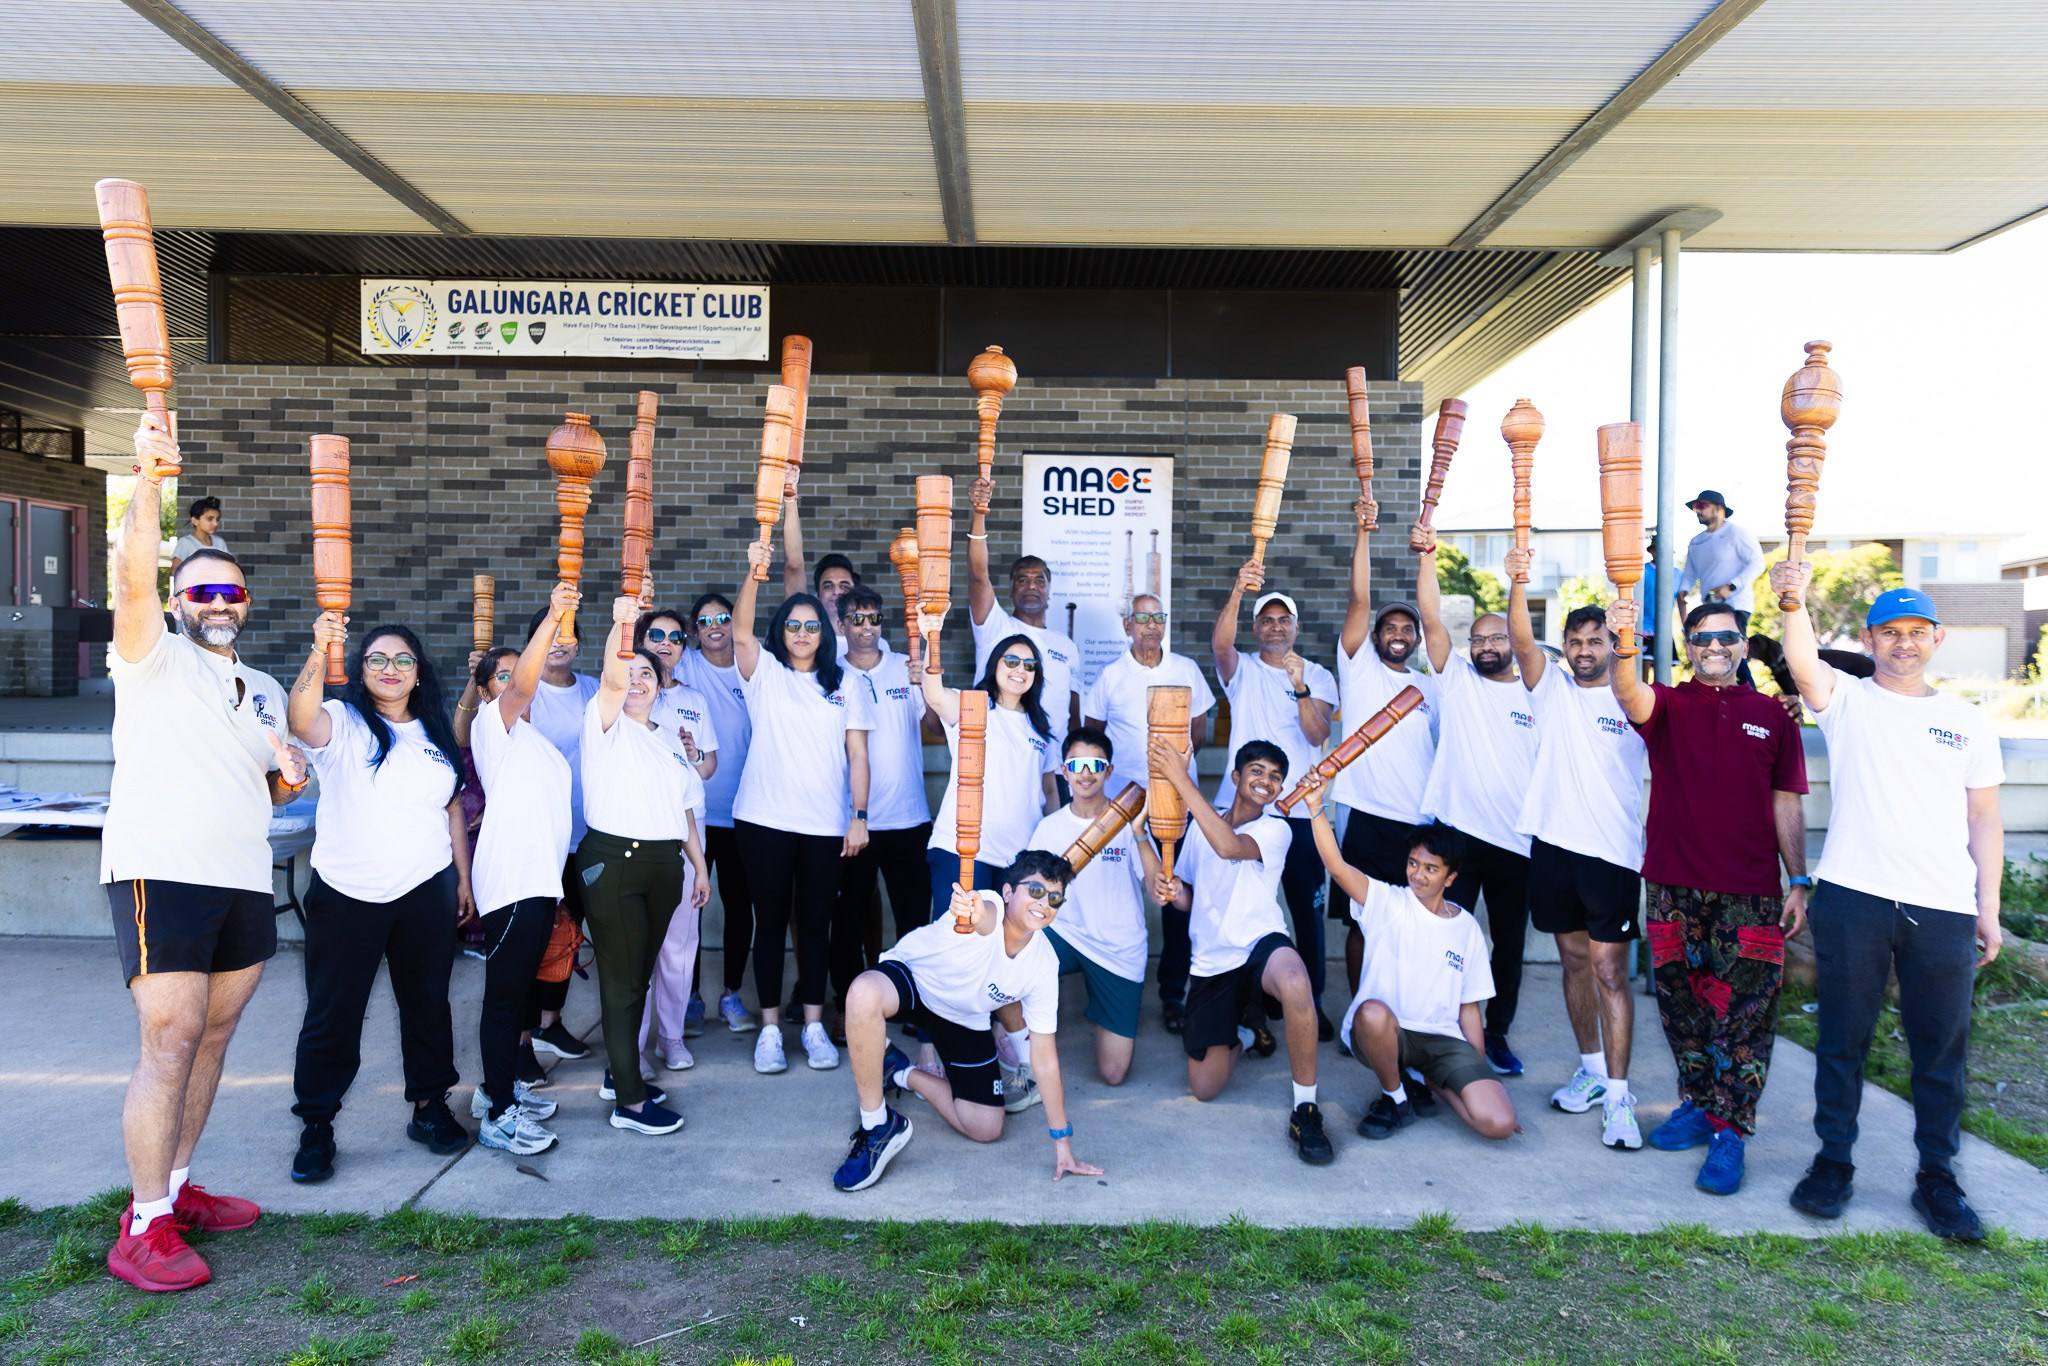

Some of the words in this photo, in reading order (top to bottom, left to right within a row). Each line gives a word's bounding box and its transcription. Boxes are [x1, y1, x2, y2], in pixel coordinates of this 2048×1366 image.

[448, 289, 591, 315] GALUNGARA
[598, 291, 696, 318] CRICKET
[703, 293, 762, 319] CLUB
[660, 324, 698, 332] Development
[703, 325, 742, 333] Opportunities
[1043, 466, 1152, 494] MACE
[1043, 496, 1115, 516] SHED
[1597, 716, 1629, 731] MACE
[1602, 725, 1624, 736] SHED
[1929, 727, 1970, 747] MACE
[1936, 736, 1963, 751] SHED
